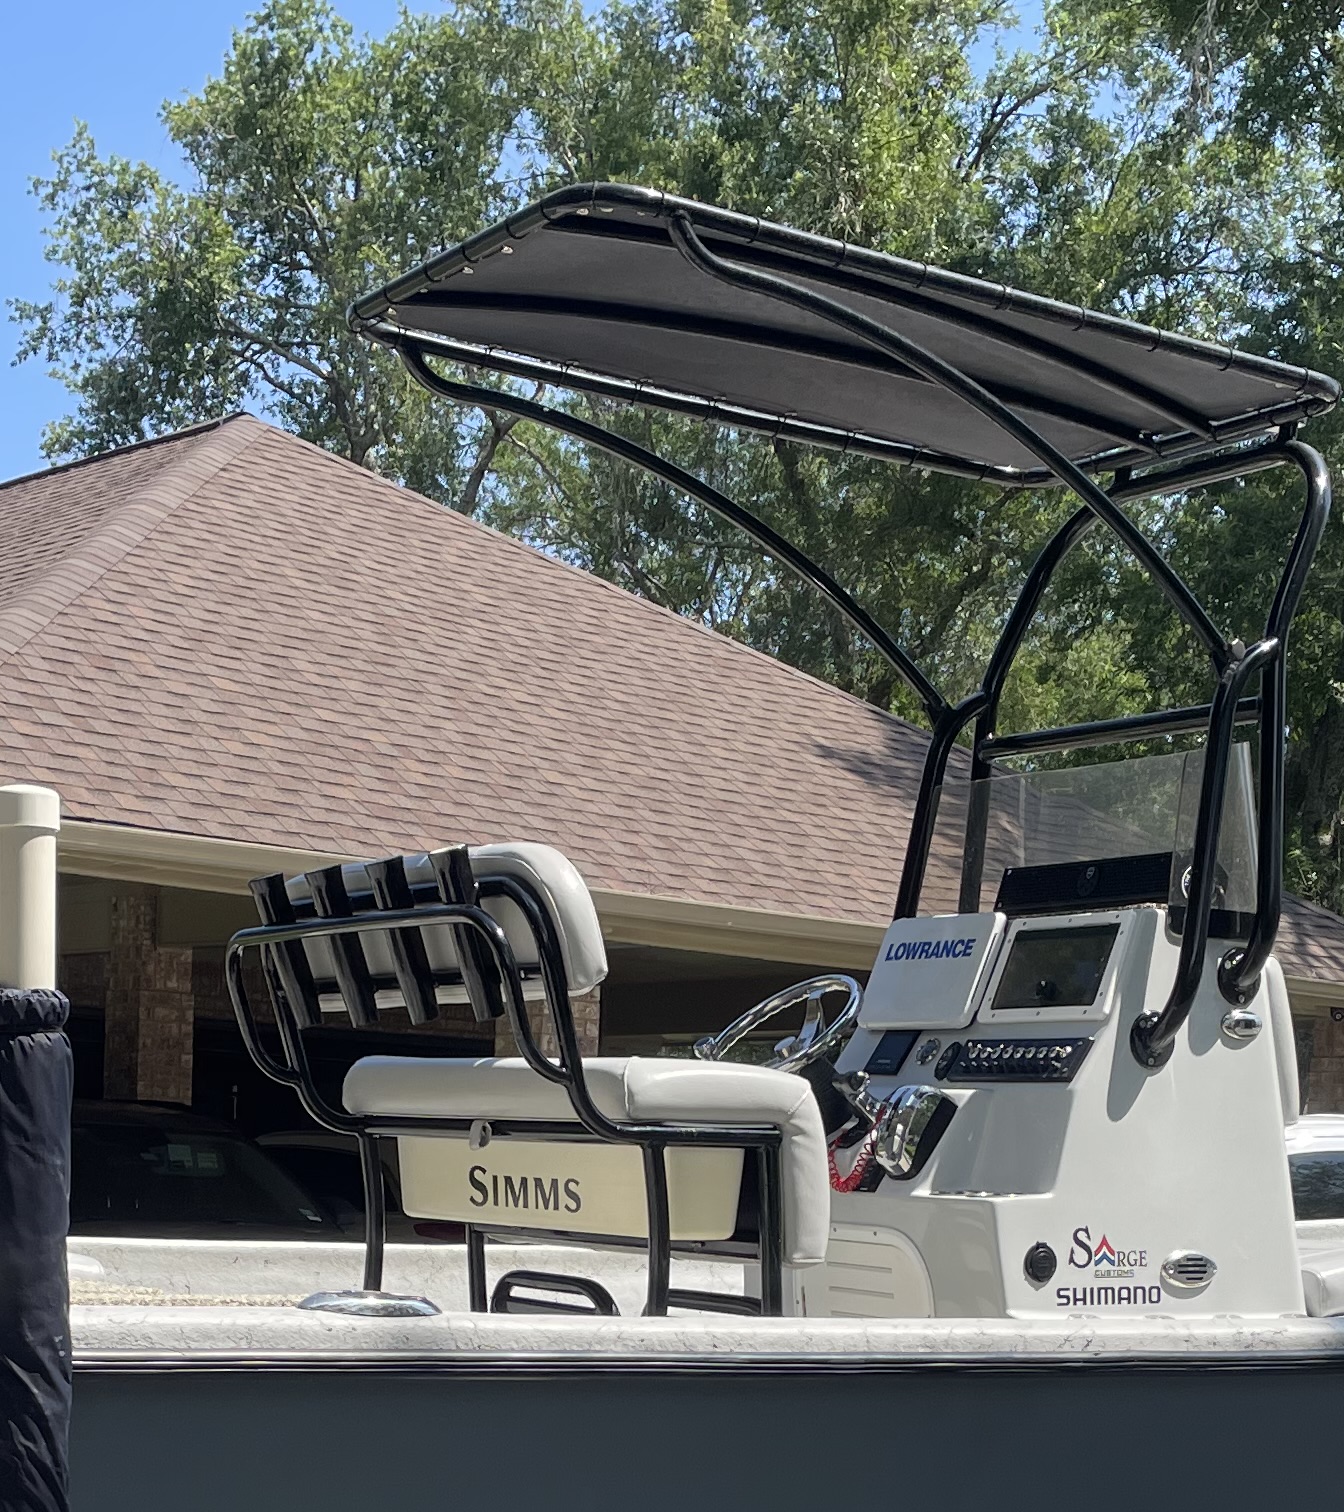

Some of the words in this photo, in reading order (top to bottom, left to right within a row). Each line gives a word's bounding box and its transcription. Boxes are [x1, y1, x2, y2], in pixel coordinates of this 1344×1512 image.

[884, 938, 977, 962] LOWRANCE
[468, 1165, 582, 1213] SIMMS
[1056, 1285, 1161, 1307] SHIMANO
